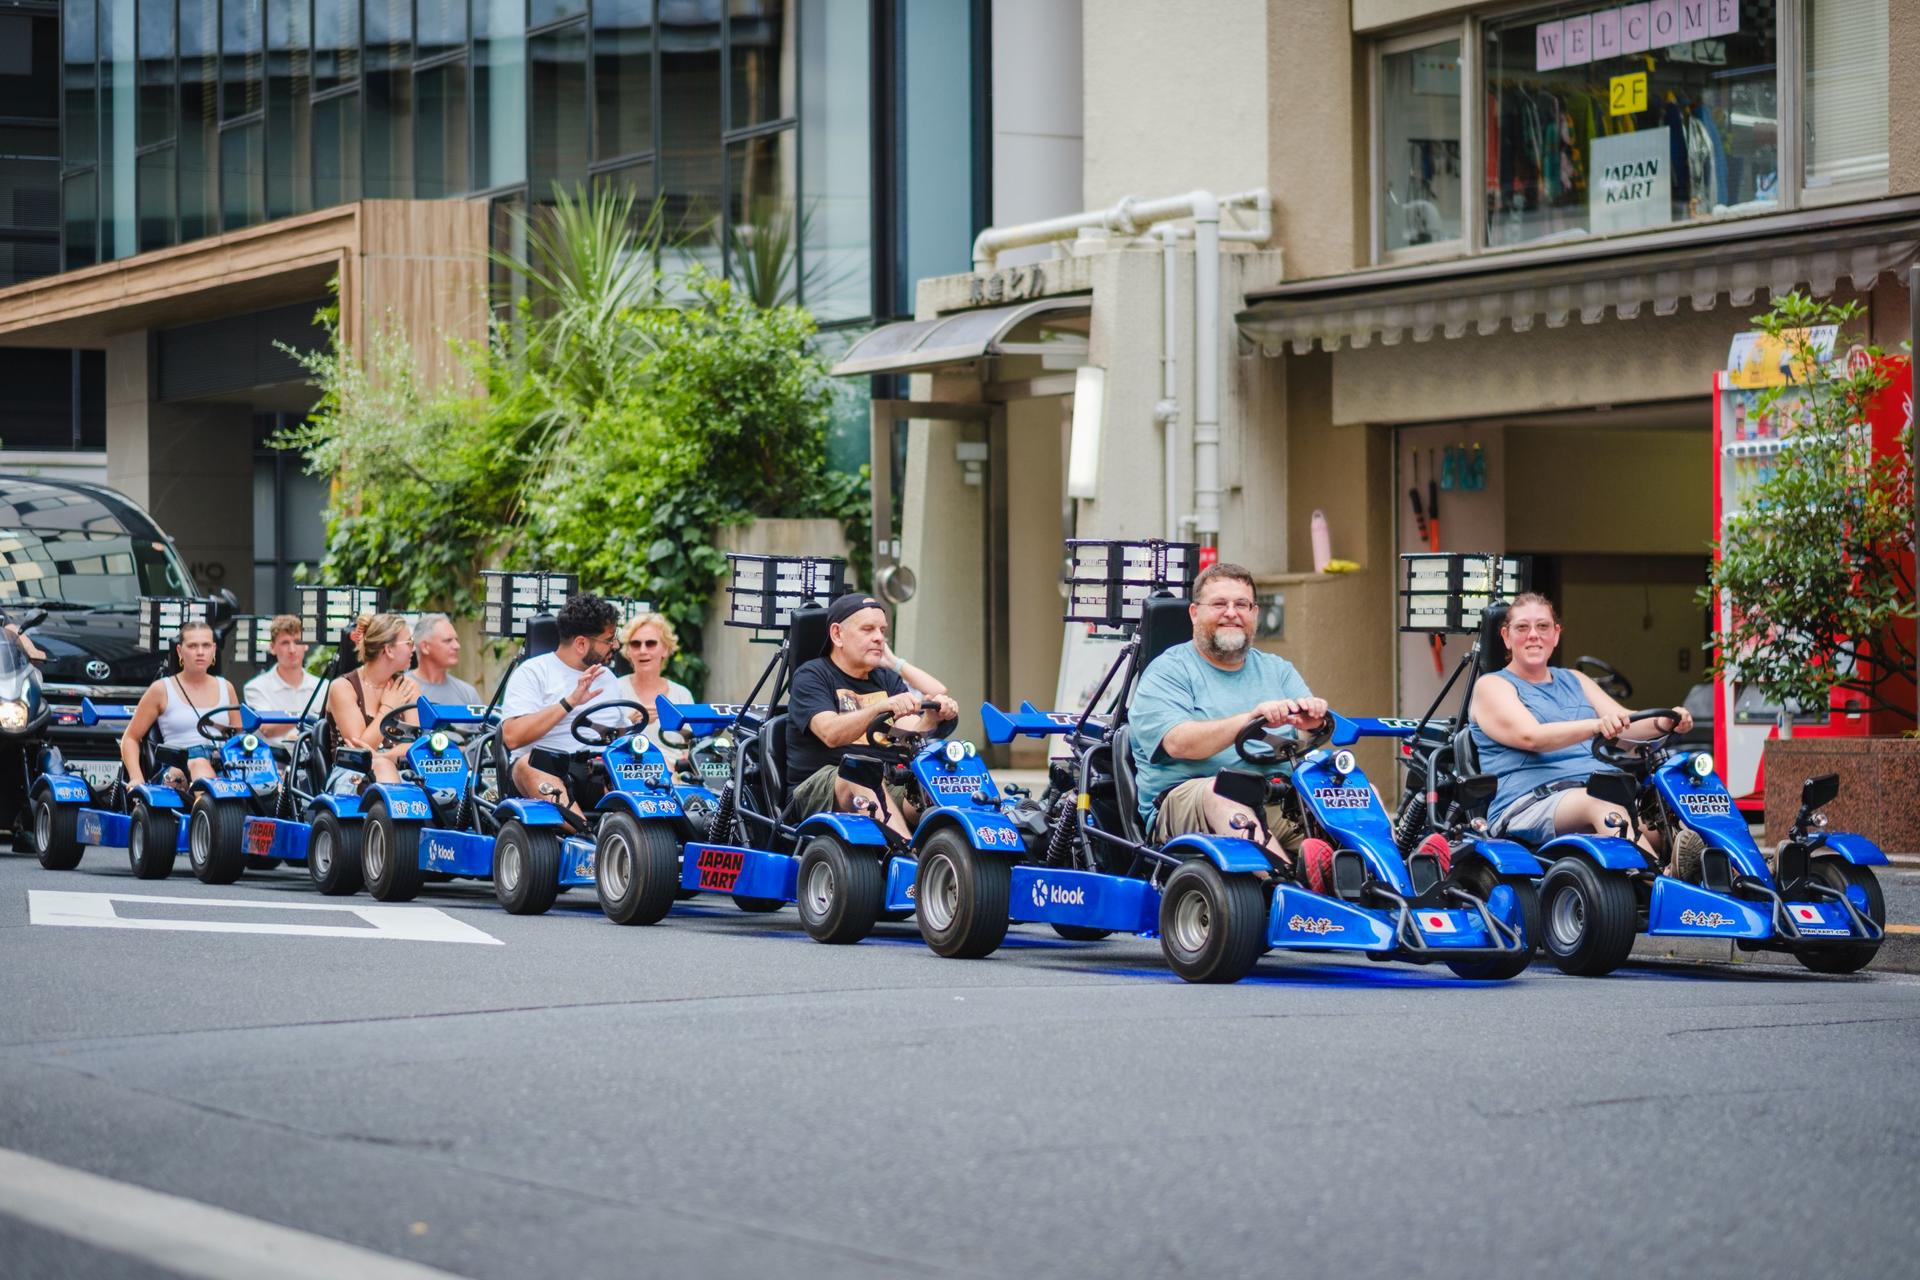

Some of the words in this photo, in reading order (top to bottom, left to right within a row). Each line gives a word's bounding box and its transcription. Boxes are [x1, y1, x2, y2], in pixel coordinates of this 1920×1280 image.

[1541, 0, 1731, 57] WELCOME
[1612, 79, 1645, 109] 2F
[1604, 158, 1659, 182] JAPAN
[1605, 179, 1655, 204] KART
[417, 759, 462, 768] JAPAN
[424, 766, 461, 774] KART
[617, 763, 664, 772] JAPAN
[700, 762, 731, 771] JAPA
[931, 776, 982, 785] JAPAN
[940, 784, 981, 794] KART
[1313, 788, 1371, 799] JAPAN
[1323, 798, 1371, 809] KART
[1680, 793, 1730, 804] JAPAN
[639, 799, 677, 814] 雷神
[1688, 803, 1730, 814] KART
[977, 826, 1018, 847] 雷神
[698, 850, 744, 871] JAPAN
[701, 870, 738, 890] KART
[1051, 885, 1085, 905] klook
[1288, 914, 1345, 935] 安全第一
[1680, 909, 1736, 928] 安全第一
